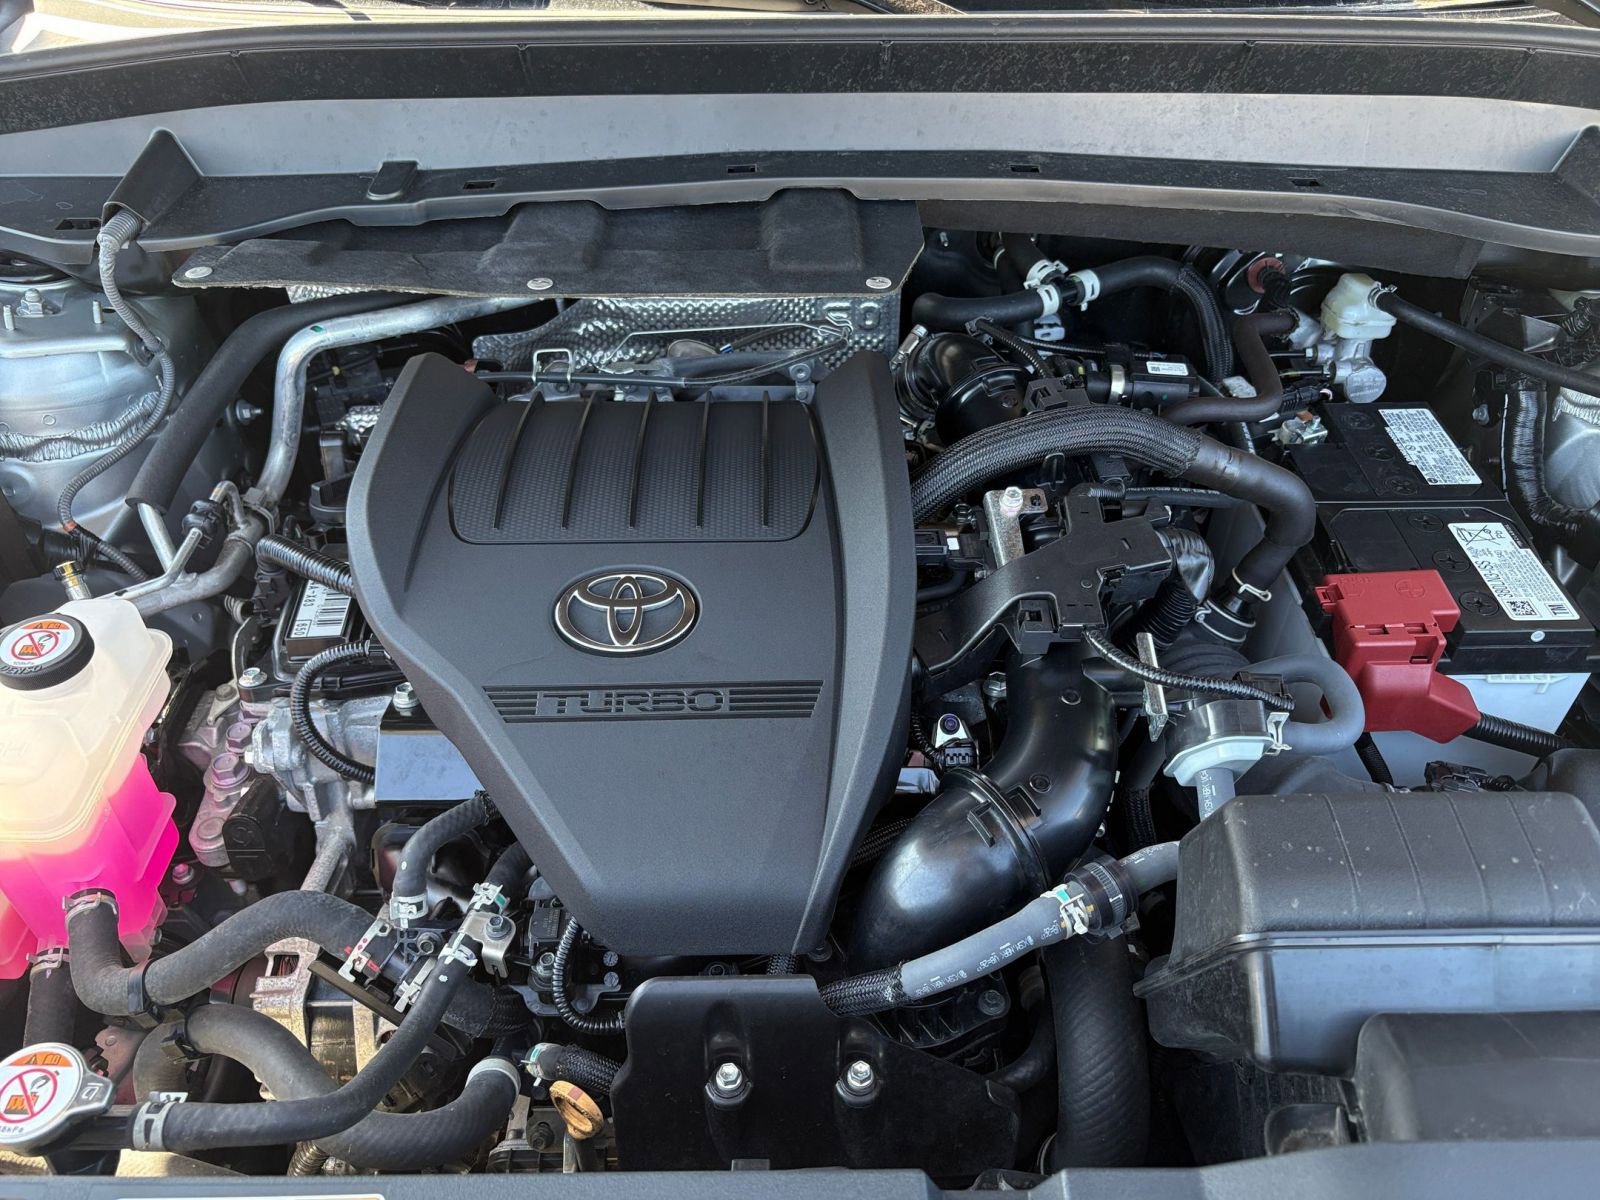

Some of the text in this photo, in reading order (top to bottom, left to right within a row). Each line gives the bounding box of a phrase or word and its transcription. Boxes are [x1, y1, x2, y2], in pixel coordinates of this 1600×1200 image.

[1494, 530, 1506, 539] Pb
[1548, 604, 1570, 616] TM
[0, 664, 43, 675] DENSO
[541, 688, 729, 715] TURBO
